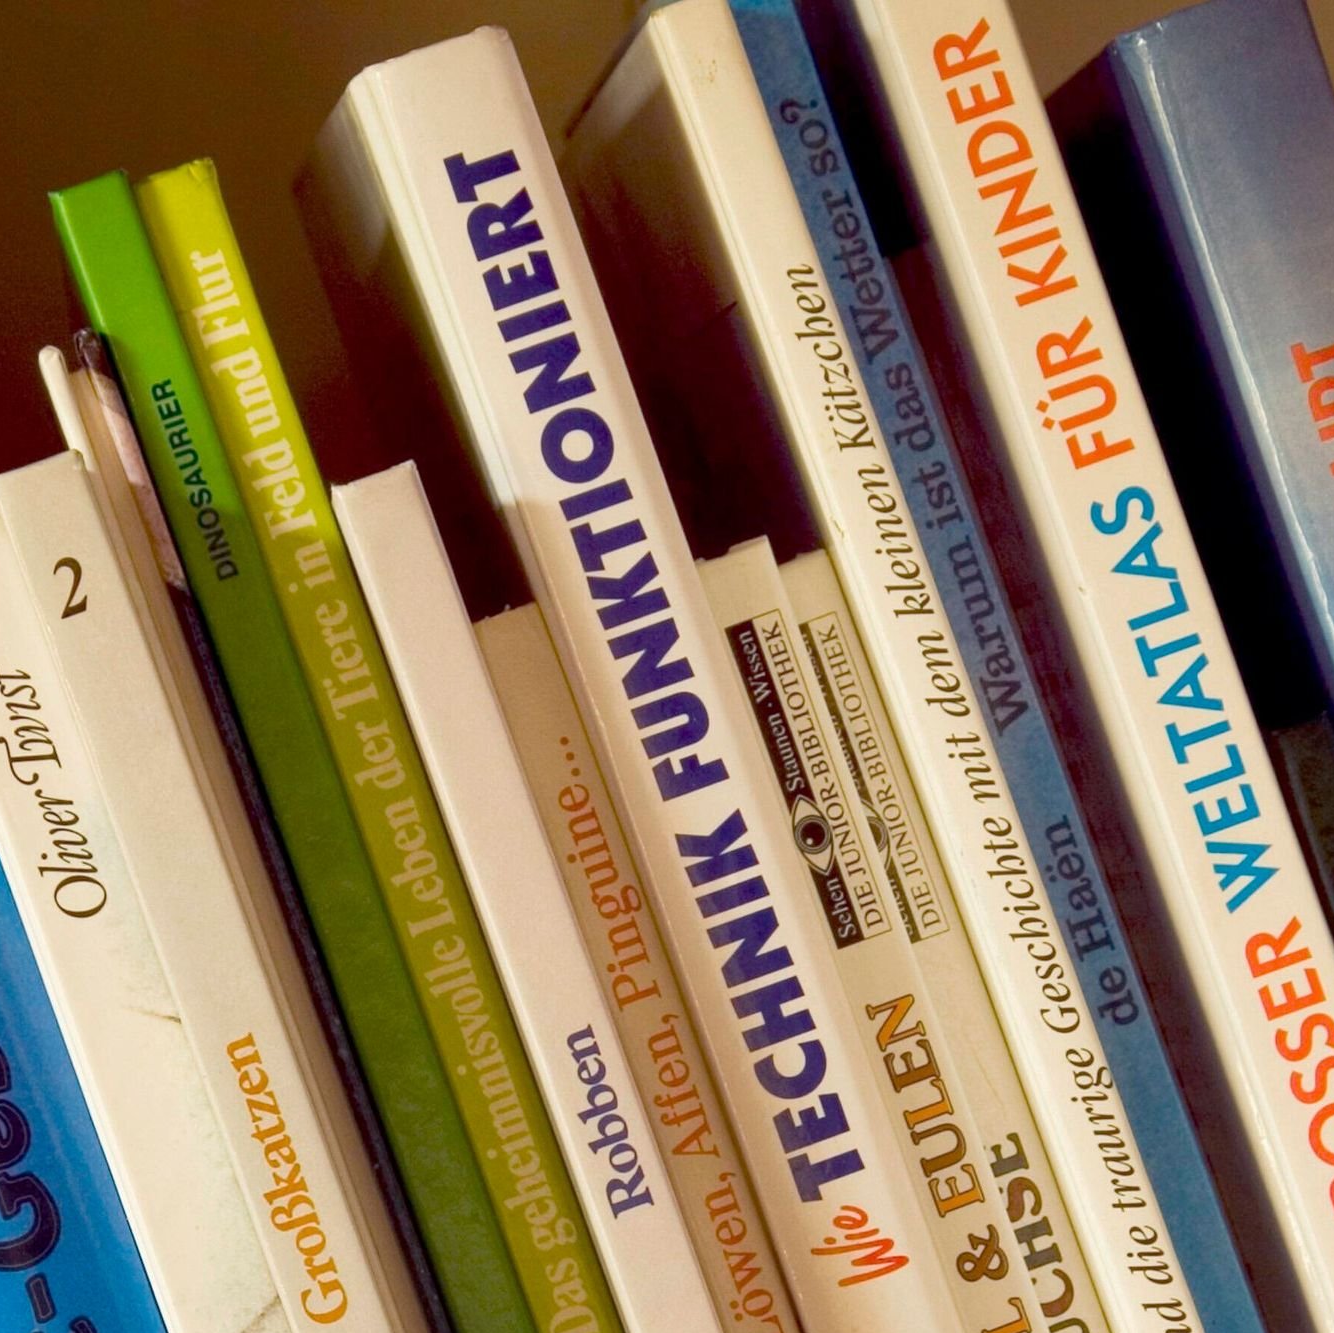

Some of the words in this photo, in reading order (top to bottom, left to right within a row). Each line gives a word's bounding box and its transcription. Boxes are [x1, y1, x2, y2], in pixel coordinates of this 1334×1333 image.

[780, 97, 840, 176] so?
[932, 17, 1079, 308] KINDER
[186, 245, 250, 362] Flur
[821, 184, 900, 364] Wetter
[210, 356, 283, 444] und
[785, 262, 875, 452] Kätzchen
[884, 363, 936, 453] das
[1034, 315, 1136, 469] FÜR
[151, 378, 239, 581] DINOSAURIER
[242, 442, 317, 550] Feld
[443, 148, 730, 801] FUNKTIONIERT
[908, 461, 963, 531] ist
[52, 556, 88, 620] 2
[287, 549, 336, 600] in
[868, 463, 935, 619] kleinen
[316, 599, 380, 720] Tiere
[740, 631, 774, 704] Wissen
[921, 627, 976, 726] dem
[940, 530, 1029, 737] Warum
[351, 716, 406, 791] der
[763, 714, 805, 791] Staunen
[763, 622, 873, 883] JUNIOR-BIBLIOTHEK
[817, 623, 926, 883] JUNIOR-BIBLIOTHEK
[1089, 484, 1281, 914] WELTATLAS
[948, 736, 1002, 806] mit
[37, 789, 108, 919] Oliver
[388, 795, 453, 942] Leben
[819, 877, 858, 939] Sehen
[854, 884, 884, 931] DIE
[913, 882, 941, 930] DIE
[1046, 813, 1121, 962] Haën
[984, 815, 1080, 1033] Geschichte
[674, 809, 865, 1203] TECHNIK
[1095, 968, 1139, 1029] de
[422, 933, 579, 1252] geheimnisvolle
[566, 1024, 654, 1219] Robben
[649, 1012, 721, 1160] Affen,
[867, 992, 985, 1218] EULEN
[1067, 1046, 1150, 1216] traurige
[226, 1032, 349, 1327] Großkatzen
[810, 1204, 910, 1288] Wie
[957, 1224, 1008, 1283] &
[1127, 1223, 1176, 1288] die
